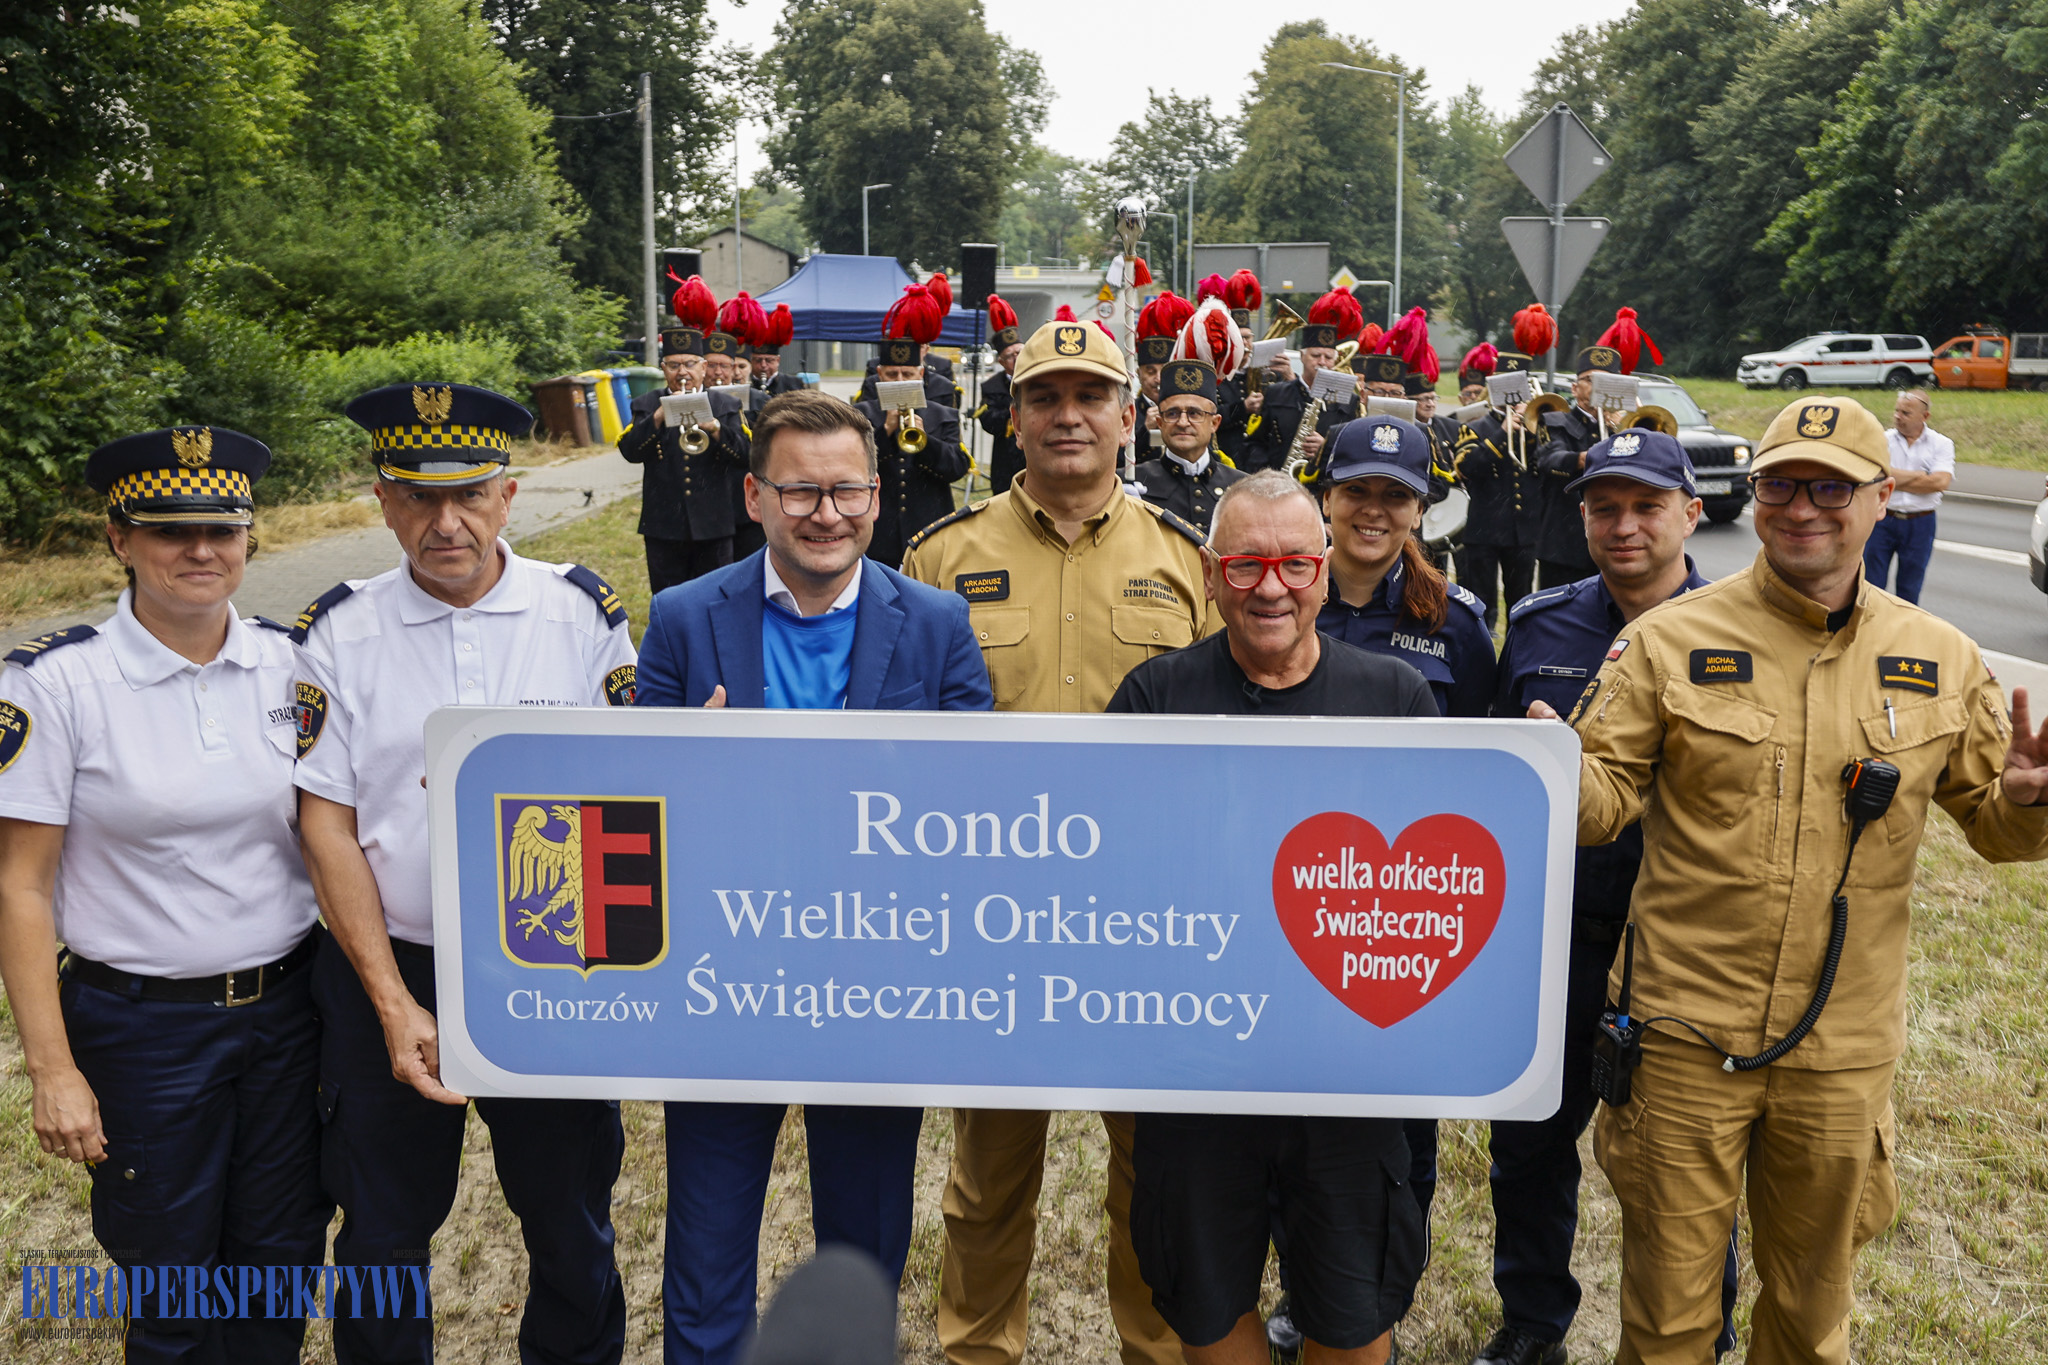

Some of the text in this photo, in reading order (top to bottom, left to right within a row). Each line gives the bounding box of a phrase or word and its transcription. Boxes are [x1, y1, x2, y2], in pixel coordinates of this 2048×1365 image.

[964, 578, 1002, 587] ARKADIUSZ
[1123, 589, 1179, 604] STRAŻ POŻARNA
[1129, 578, 1173, 594] PAŃSTWOWA
[1391, 632, 1446, 659] POLICJA
[1705, 665, 1738, 673] ADAMEK
[1706, 657, 1736, 665] MICHAŁ
[609, 675, 637, 694] MIEJSK
[850, 791, 1101, 859] Rondo
[1293, 846, 1484, 895] wielka orkiestra
[712, 889, 1241, 961] Wielkiej Orkiestry
[1313, 896, 1464, 958] świątecznej
[1342, 950, 1441, 994] pomocy
[506, 989, 661, 1023] Chorzów
[685, 953, 1271, 1041] Świątecznej Pomocy
